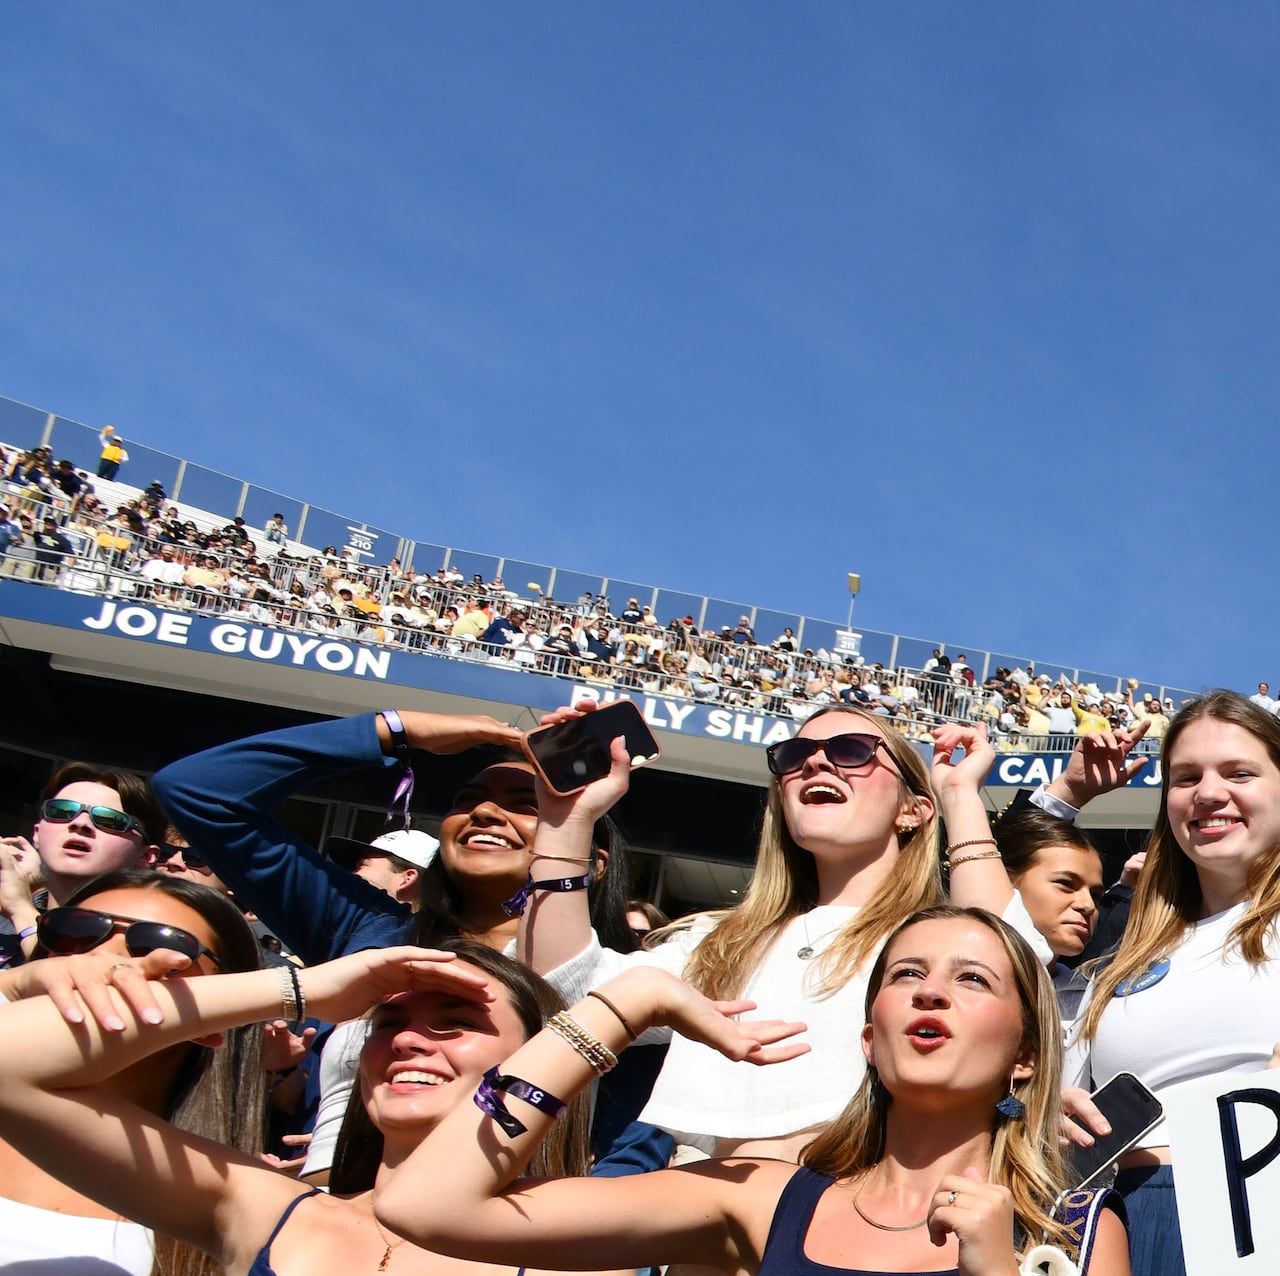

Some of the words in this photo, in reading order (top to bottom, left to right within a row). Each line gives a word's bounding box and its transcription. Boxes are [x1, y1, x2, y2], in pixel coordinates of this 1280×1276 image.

[350, 538, 371, 551] 210
[82, 602, 192, 645] JOE
[210, 623, 391, 679] GUYON
[704, 710, 801, 748] SHA
